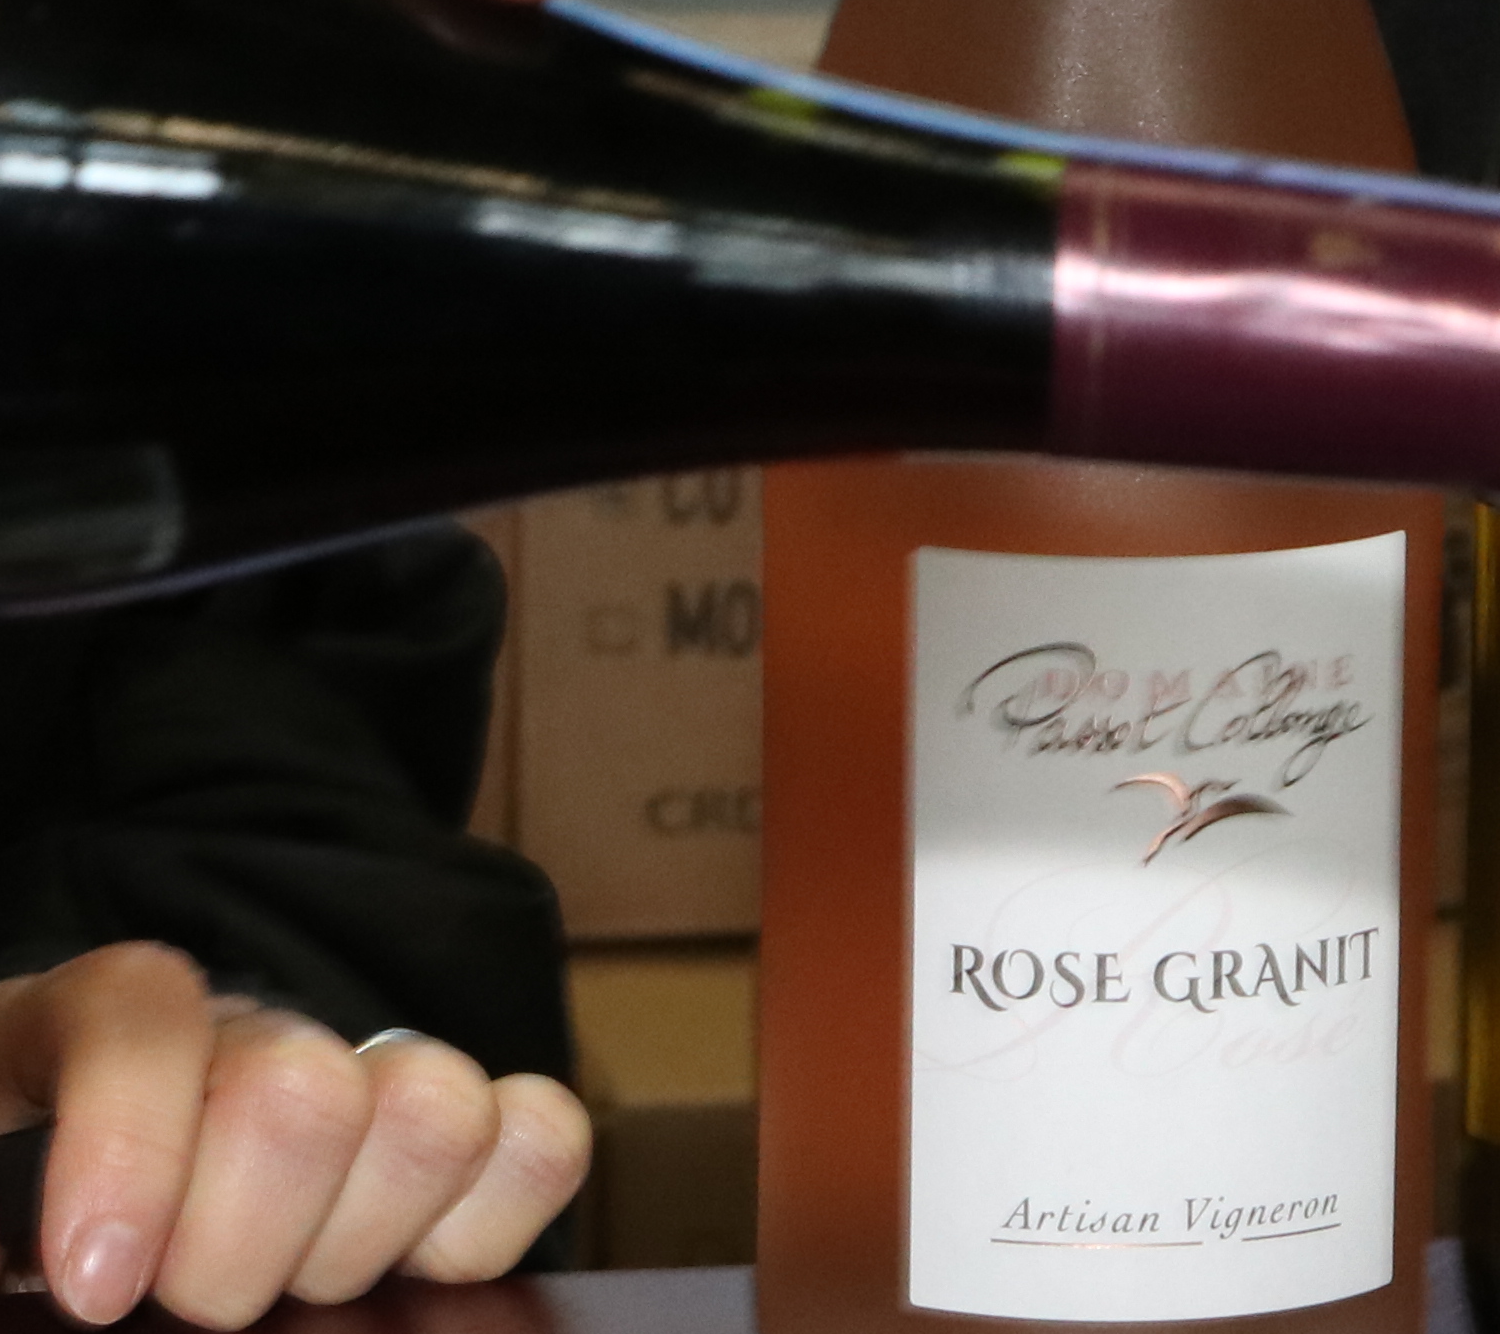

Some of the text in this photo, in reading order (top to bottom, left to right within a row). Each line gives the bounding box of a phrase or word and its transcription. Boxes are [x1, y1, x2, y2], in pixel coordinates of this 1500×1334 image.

[1036, 654, 1353, 701] DOMAINE
[950, 928, 1380, 1013] ROSE GRANIT
[1002, 1192, 1340, 1241] Artisan Vigneron
